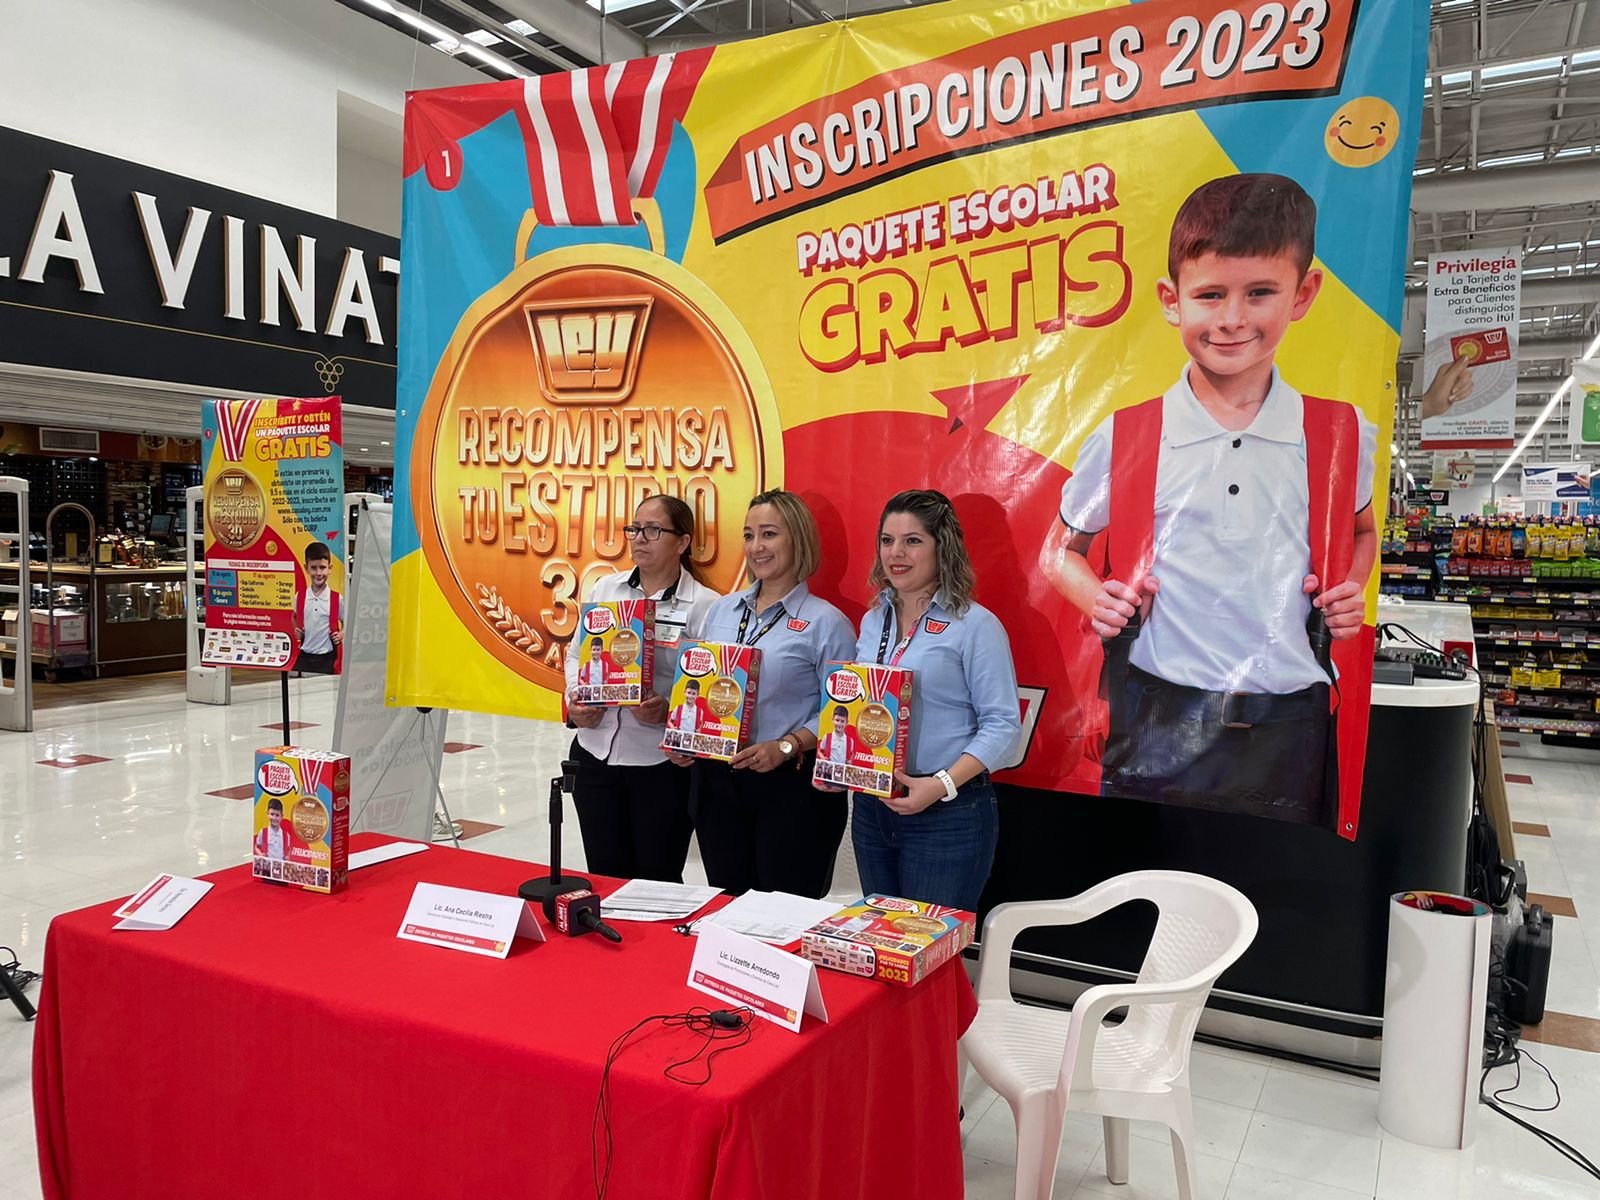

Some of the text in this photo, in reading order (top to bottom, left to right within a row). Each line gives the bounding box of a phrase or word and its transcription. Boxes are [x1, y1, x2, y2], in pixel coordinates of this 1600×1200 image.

[744, 0, 1329, 204] INSCRIPCIONES 2023
[442, 150, 451, 177] 1
[797, 163, 1118, 275] PAQUETE ESCOLAR
[0, 169, 105, 294] A
[1436, 256, 1516, 274] Privilegia
[1467, 275, 1500, 285] Tarjeta
[1503, 272, 1516, 281] de
[799, 220, 1133, 373] GRATIS
[1434, 283, 1516, 296] Extra Beneficios
[1448, 293, 1515, 307] para Clientes
[1455, 303, 1515, 315] distinguidos
[255, 414, 296, 427] INSCRÍBETE
[304, 410, 330, 422] OBTÉN
[256, 424, 330, 437] UN PAQUETE ESCOLAR
[457, 406, 735, 471] RECOMPENSA
[256, 435, 331, 461] GRATIS
[457, 471, 720, 566] TU ESTUO
[228, 524, 242, 540] 30
[587, 612, 593, 630] 1
[684, 650, 692, 670] 1
[690, 663, 710, 672] GRATIS
[830, 674, 837, 695] 1
[838, 674, 858, 682] PAQUETE
[838, 681, 858, 690] ESCOLAR
[836, 688, 857, 697] GRATIS
[262, 764, 269, 787] 1
[270, 766, 290, 774] PAQUETE
[270, 780, 290, 789] GRATIS
[456, 908, 473, 916] Cecilia
[474, 910, 492, 920] Riestra
[720, 950, 728, 959] Lic.
[730, 955, 750, 969] Lizzette
[751, 963, 780, 980] Arredondo
[879, 966, 909, 982] 2023
[744, 994, 764, 1008] ESCOLARES
